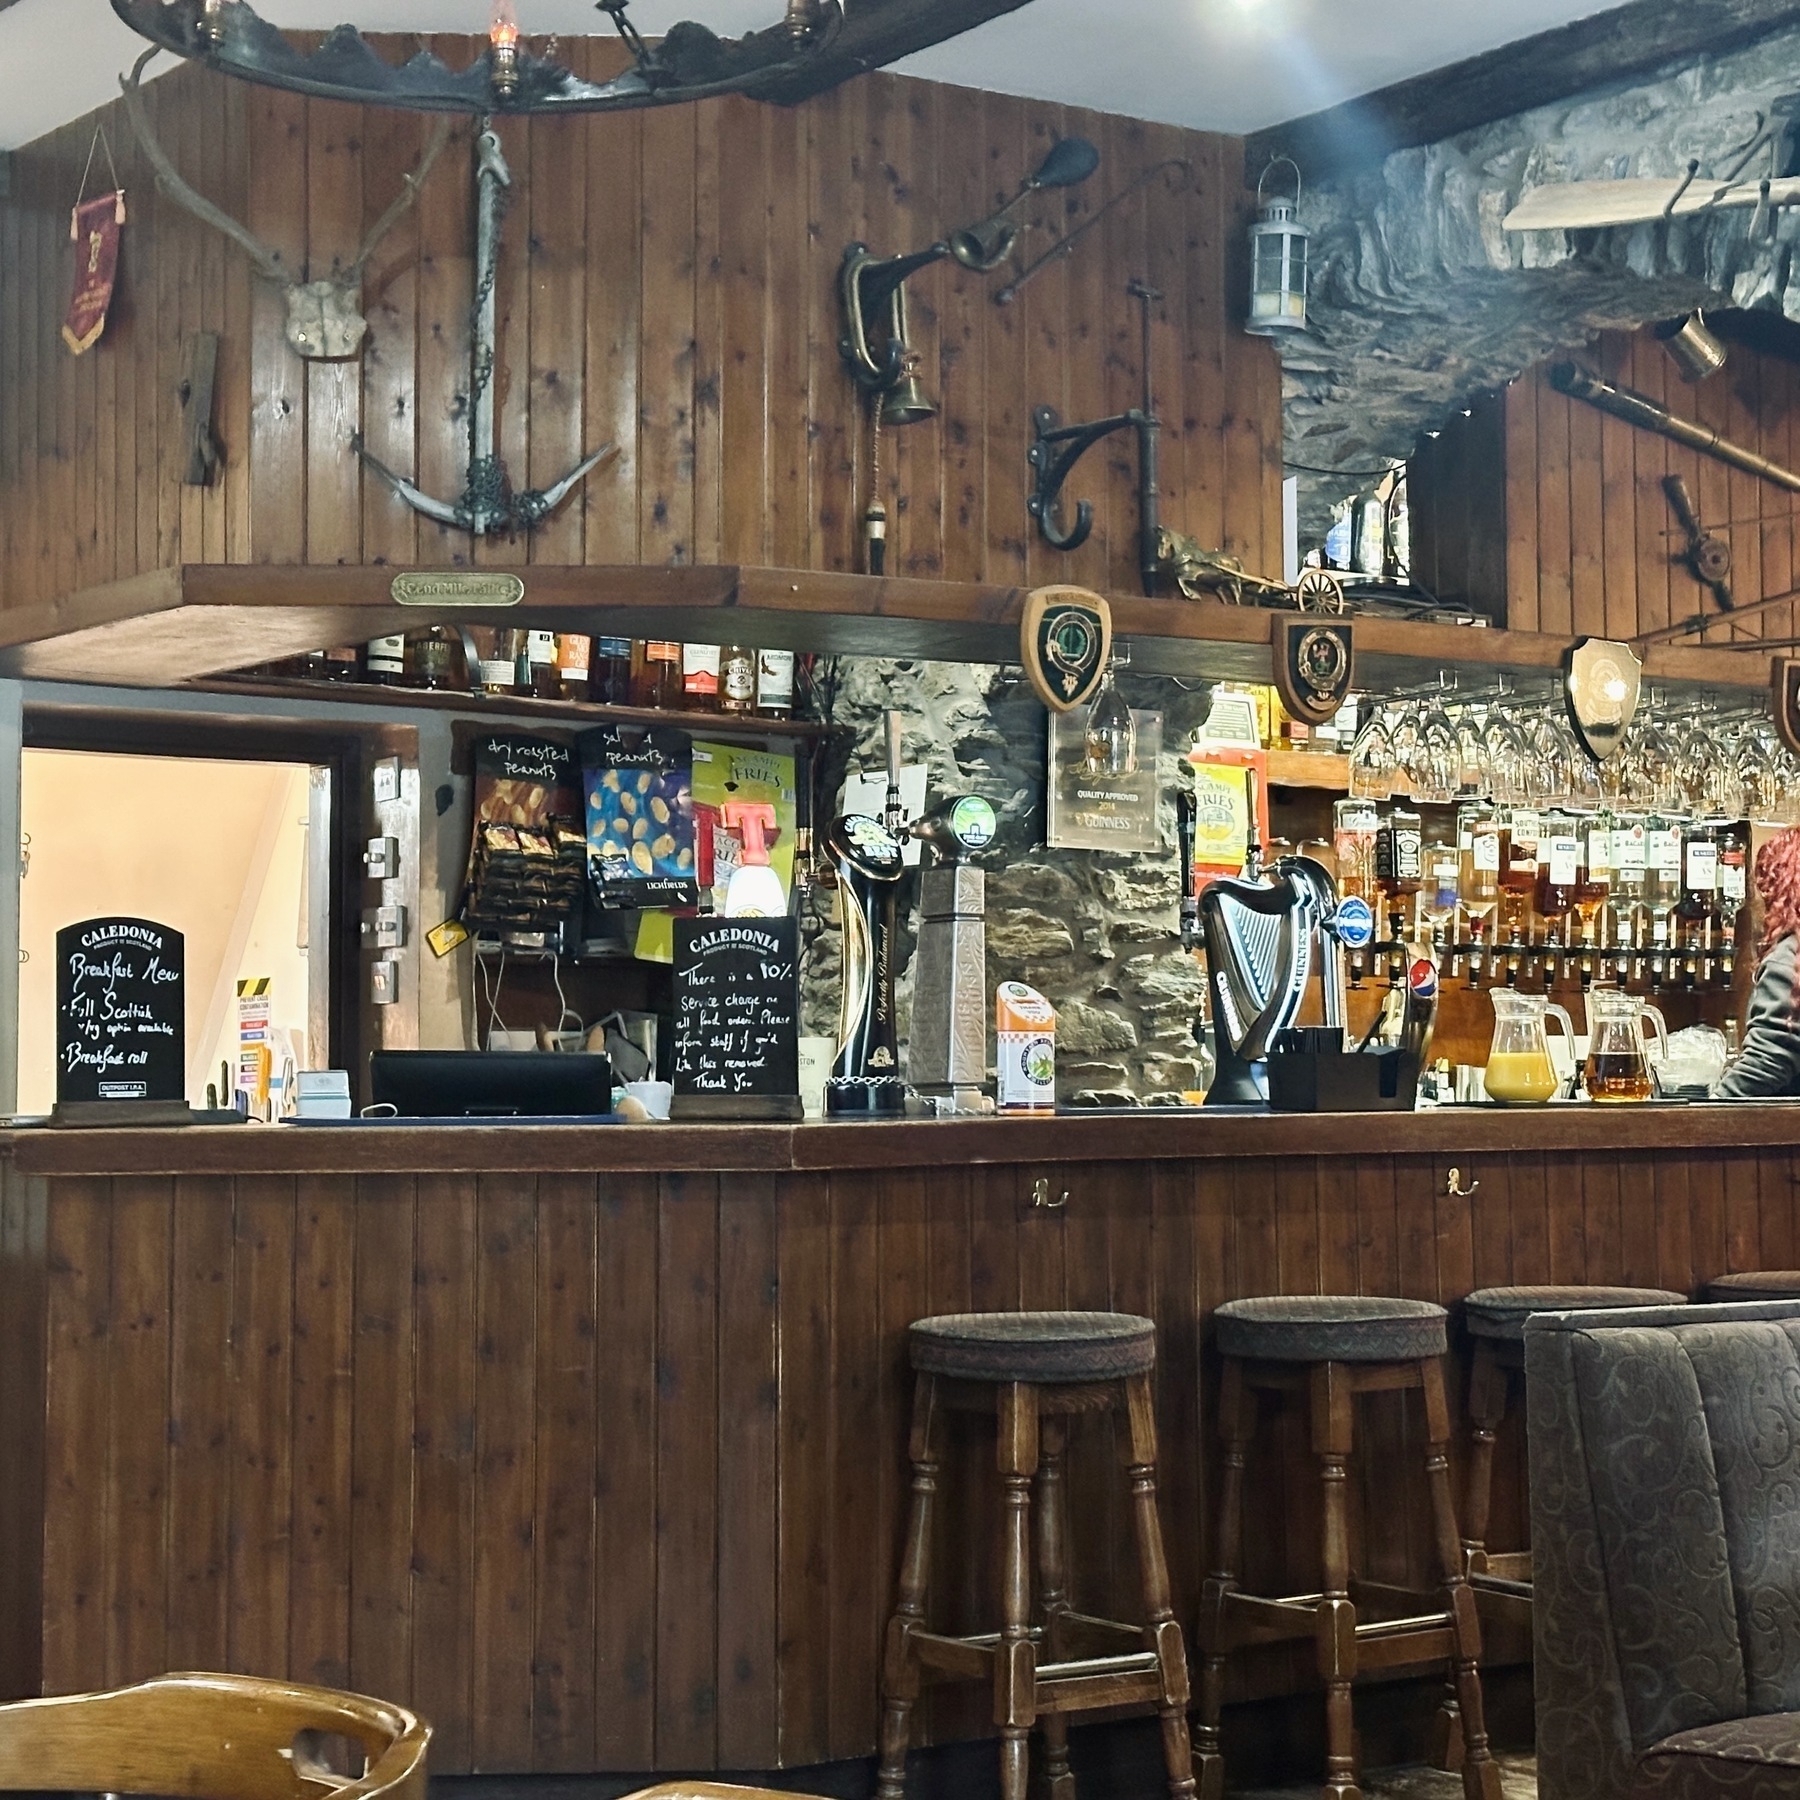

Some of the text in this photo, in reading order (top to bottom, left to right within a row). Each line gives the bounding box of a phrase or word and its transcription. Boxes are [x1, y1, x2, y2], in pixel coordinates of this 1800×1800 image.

[604, 726, 652, 745] sald
[488, 739, 570, 763] dry roasted
[734, 766, 782, 788] FRIES
[1077, 789, 1139, 802] QUALITY APPROVED
[1196, 793, 1235, 811] FRIES
[1084, 815, 1131, 830] GUINNESS
[716, 837, 739, 850] ACO
[81, 924, 163, 949] CALEDONIA
[689, 927, 780, 953] CALEDONIA
[702, 943, 730, 956] PRODUCT
[738, 943, 768, 955] SCOTLAND
[1293, 927, 1308, 992] GUINNESS
[69, 951, 180, 994] Breakfast Menu
[678, 962, 716, 986] There
[760, 962, 793, 981] 10%
[876, 922, 889, 1025] Perfectly Balanced
[70, 990, 154, 1020] Full Scottish
[725, 992, 760, 1015] charge
[676, 1017, 691, 1029] all
[699, 1009, 721, 1035] food
[760, 1008, 791, 1026] Please
[675, 1031, 703, 1056] inform
[709, 1032, 734, 1052] staff
[739, 1029, 749, 1053] if
[66, 1041, 149, 1074] Breakfast roll
[700, 1053, 717, 1070] this
[799, 1057, 816, 1066] STON
[693, 1071, 728, 1089] Thank
